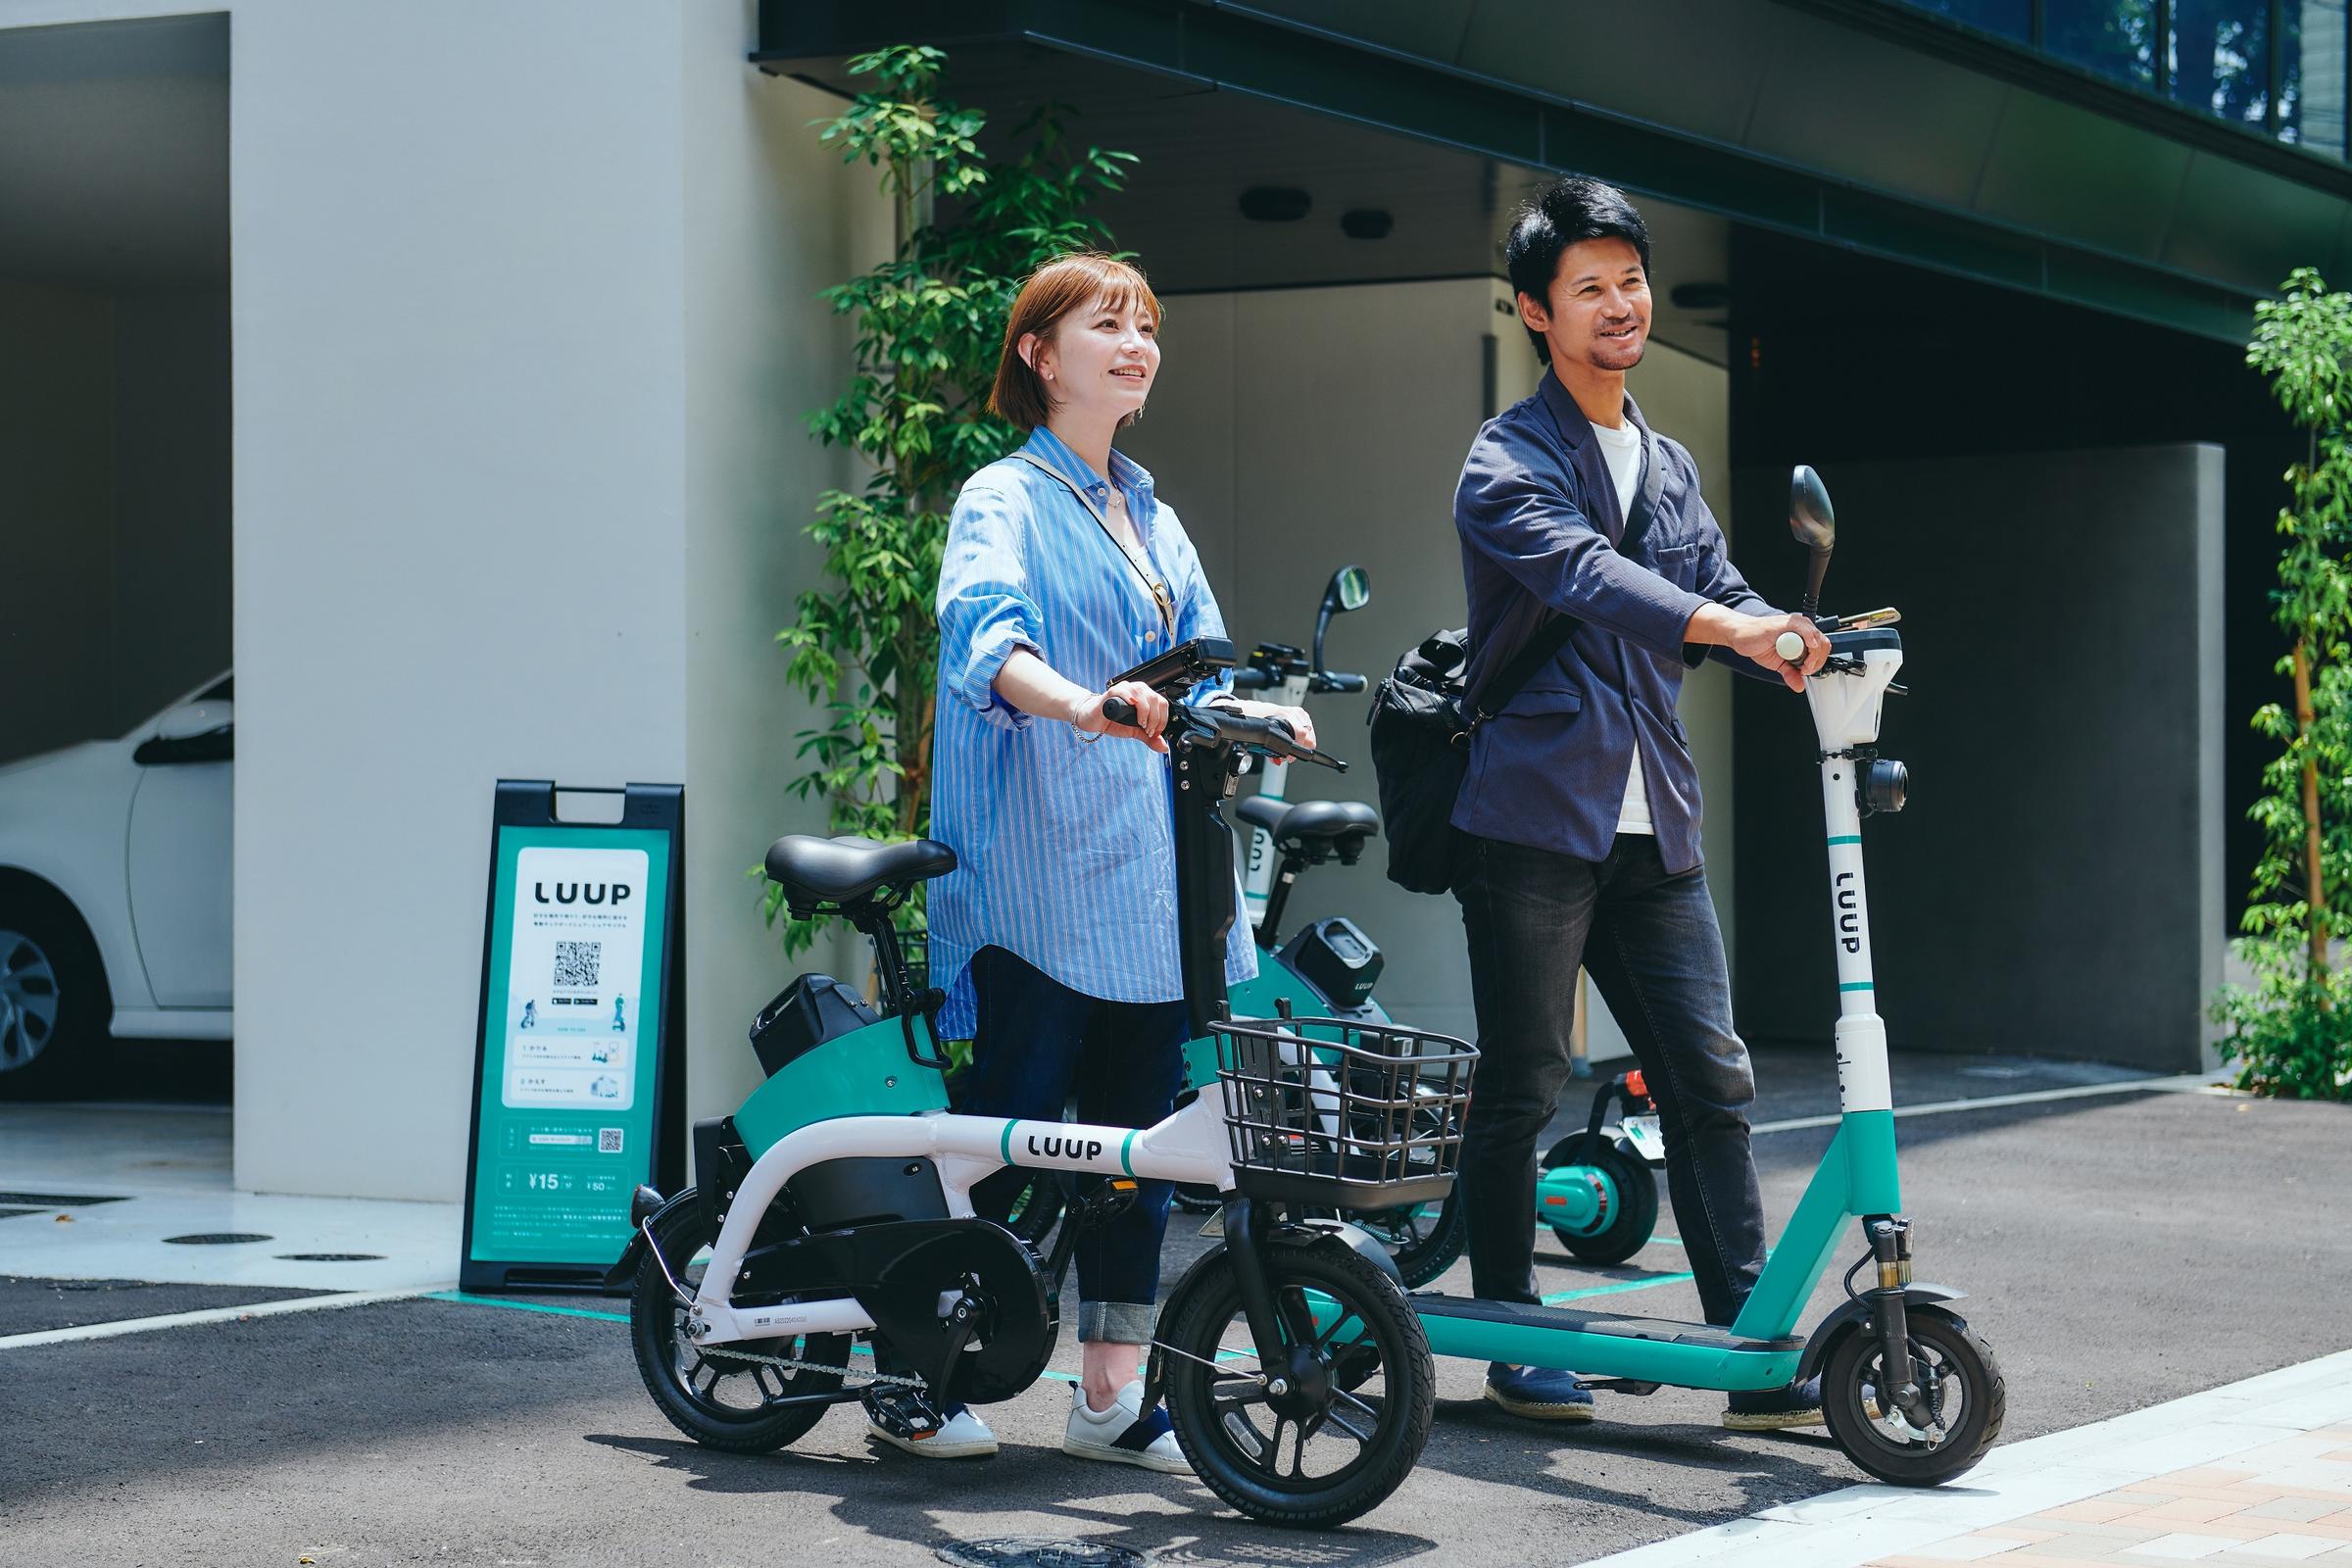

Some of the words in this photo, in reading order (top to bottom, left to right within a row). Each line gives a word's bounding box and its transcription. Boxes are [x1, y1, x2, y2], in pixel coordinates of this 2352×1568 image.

[1250, 832, 1264, 871] LUU
[535, 882, 631, 906] LUUP
[1836, 872, 1860, 954] LUUP
[1028, 1135, 1102, 1161] LUUP
